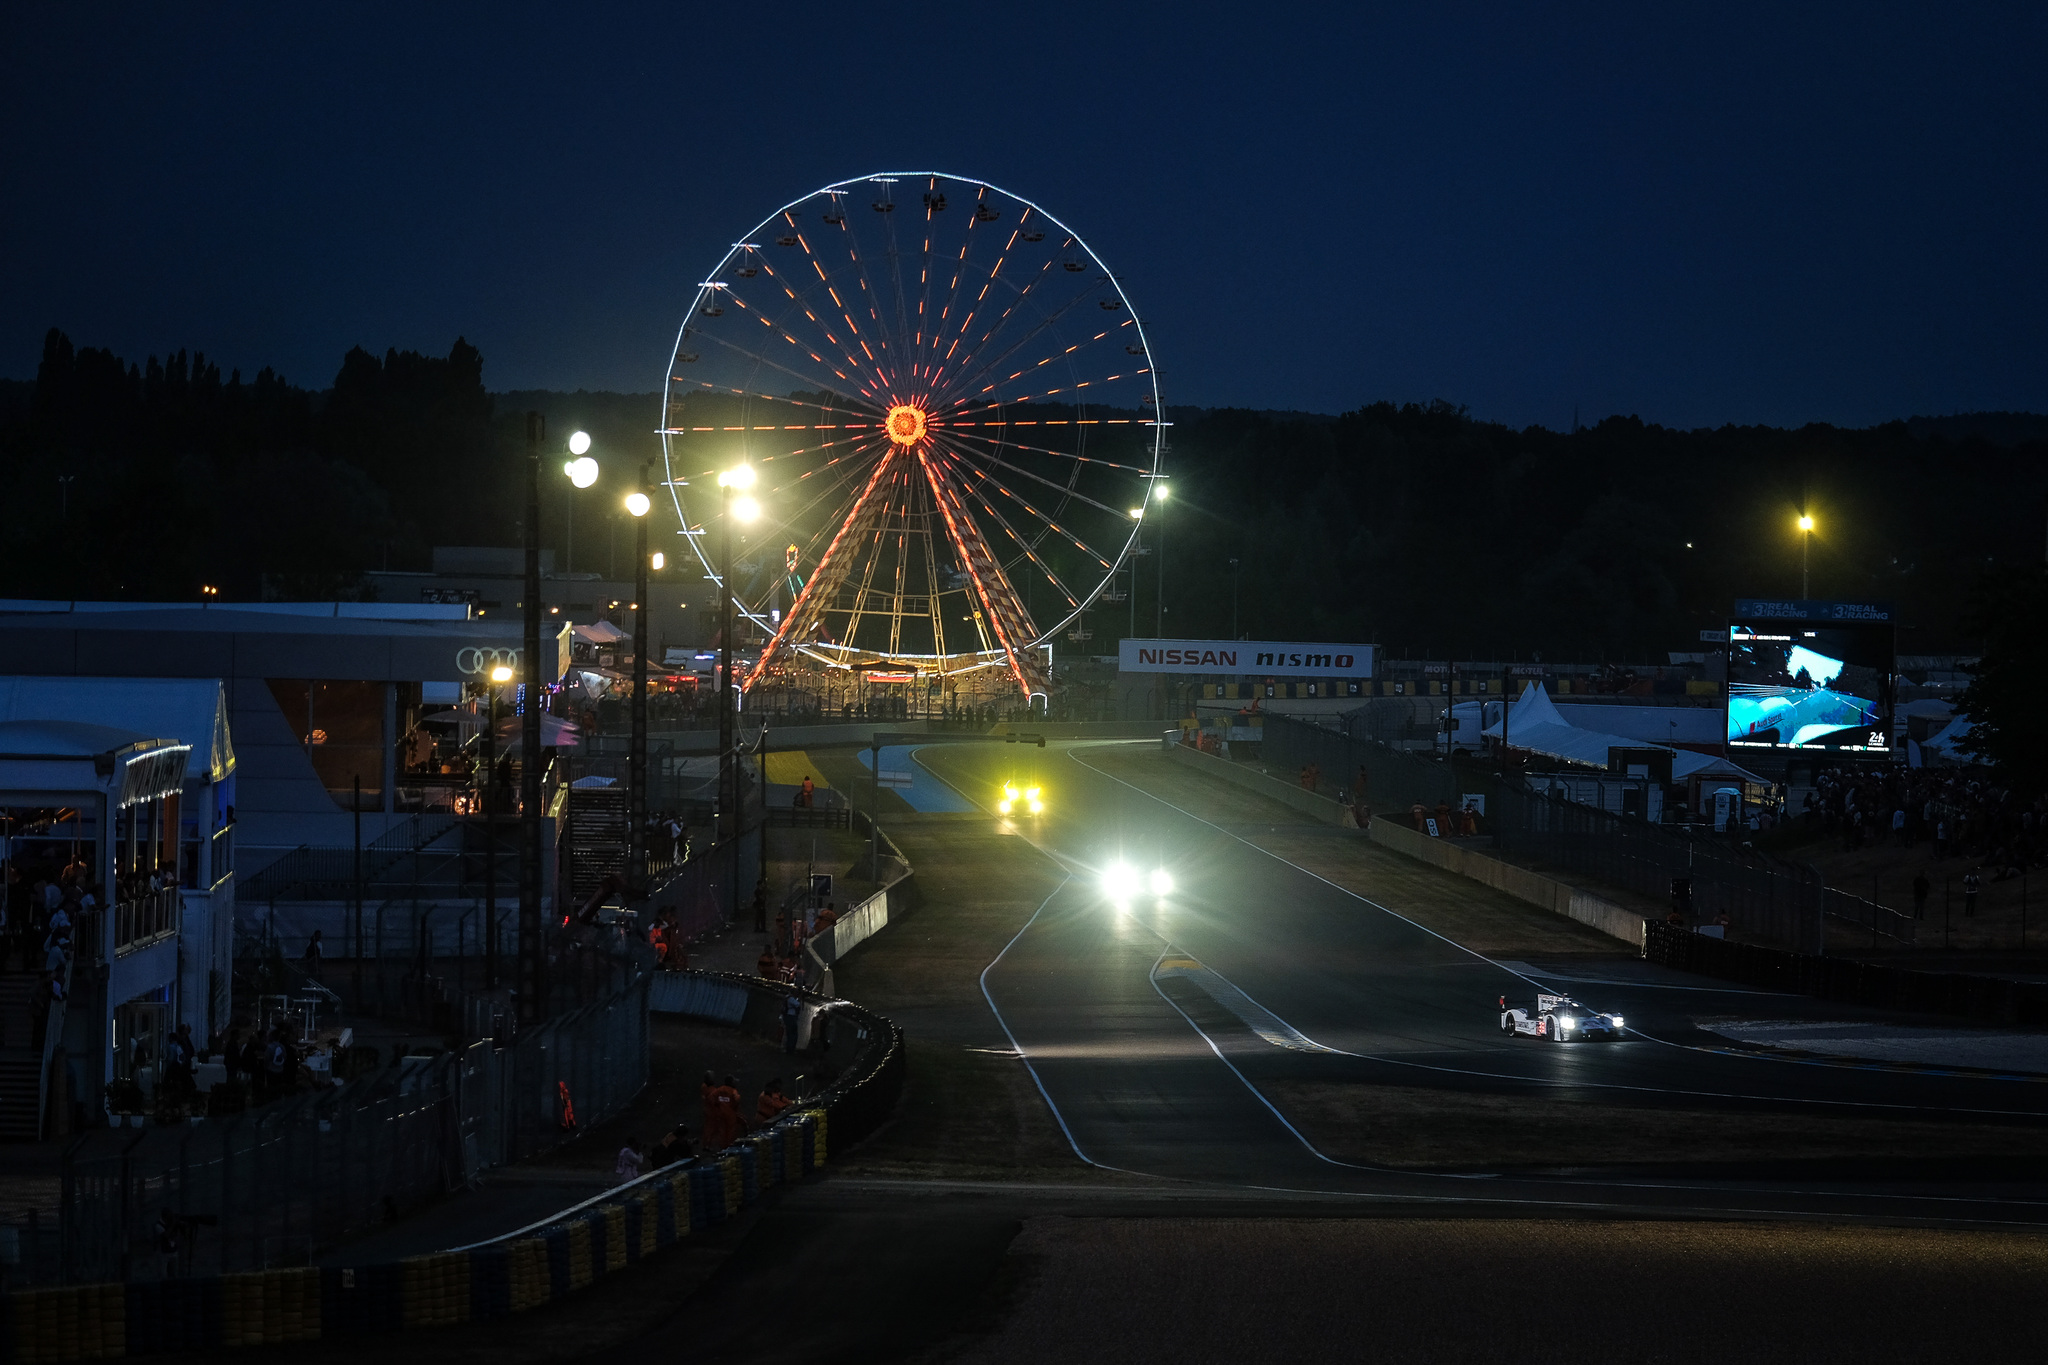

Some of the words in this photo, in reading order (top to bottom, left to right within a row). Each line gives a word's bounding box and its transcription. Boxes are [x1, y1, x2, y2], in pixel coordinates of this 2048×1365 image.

[1768, 603, 1797, 611] REAL
[1767, 610, 1808, 618] RACING
[1848, 612, 1889, 620] RACING
[1139, 648, 1237, 666] NISSAN
[1256, 651, 1354, 668] nismo
